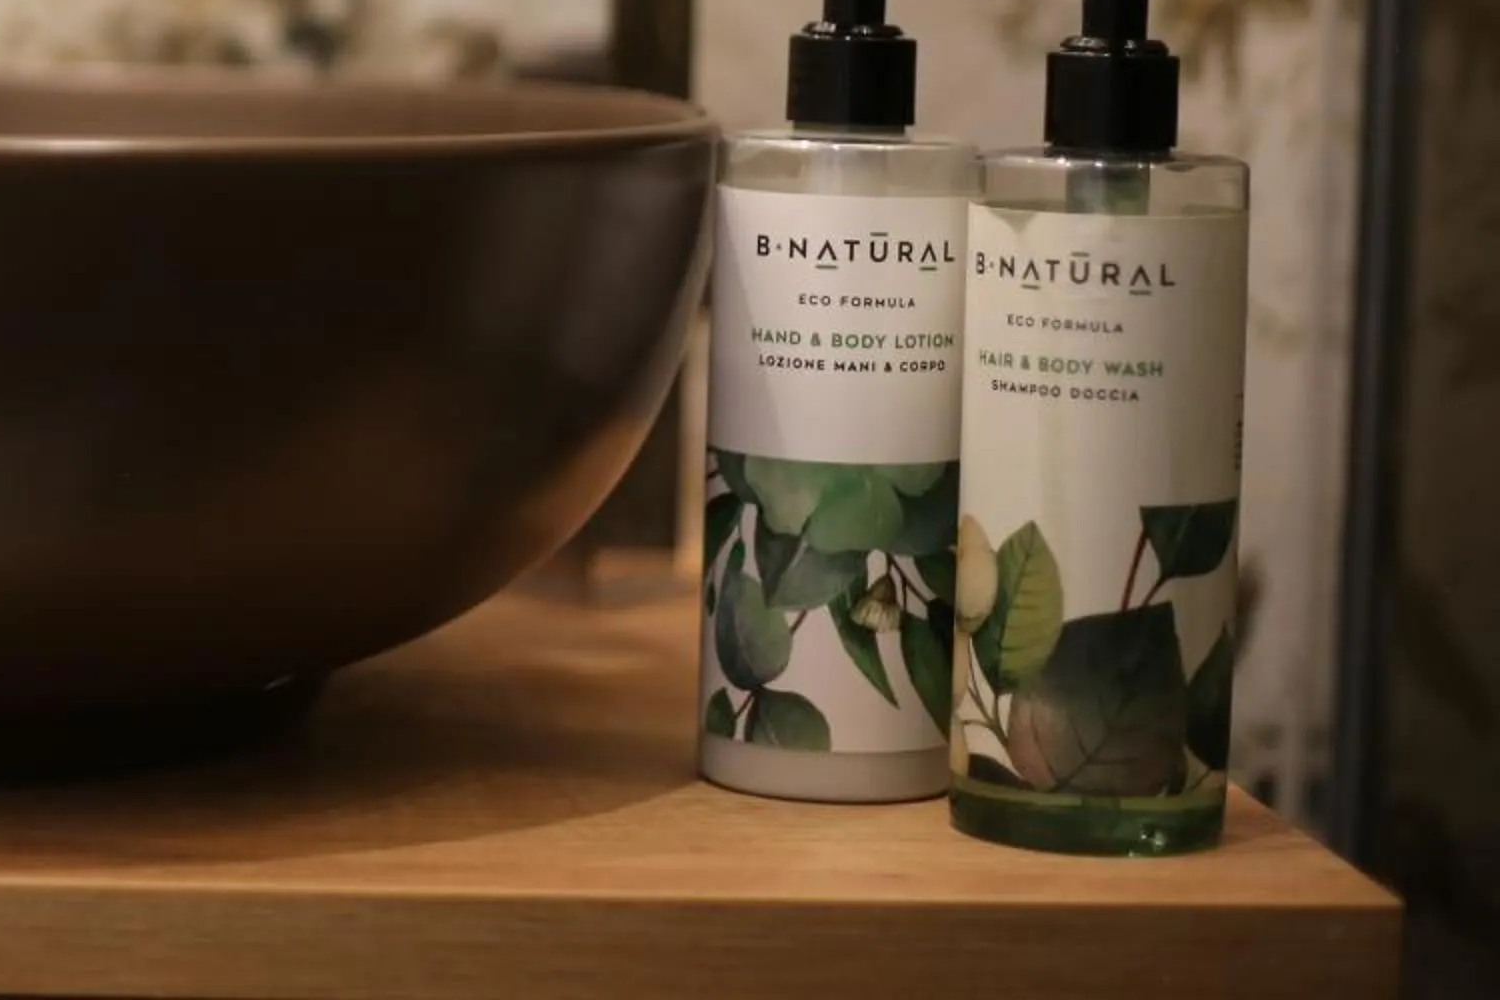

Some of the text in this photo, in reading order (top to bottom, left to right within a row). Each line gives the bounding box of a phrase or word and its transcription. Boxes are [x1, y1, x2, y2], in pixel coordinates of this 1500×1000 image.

[798, 293, 917, 309] ECO FORMULA
[1007, 313, 1125, 334] ECO FORMULA
[751, 327, 956, 350] HAND & BODY LOTION
[759, 354, 946, 373] LOZIONE MANI & CORPO
[979, 349, 1165, 378] HAIR & BODY WASH
[991, 379, 1140, 402] SHAMPOO DOCCIA
